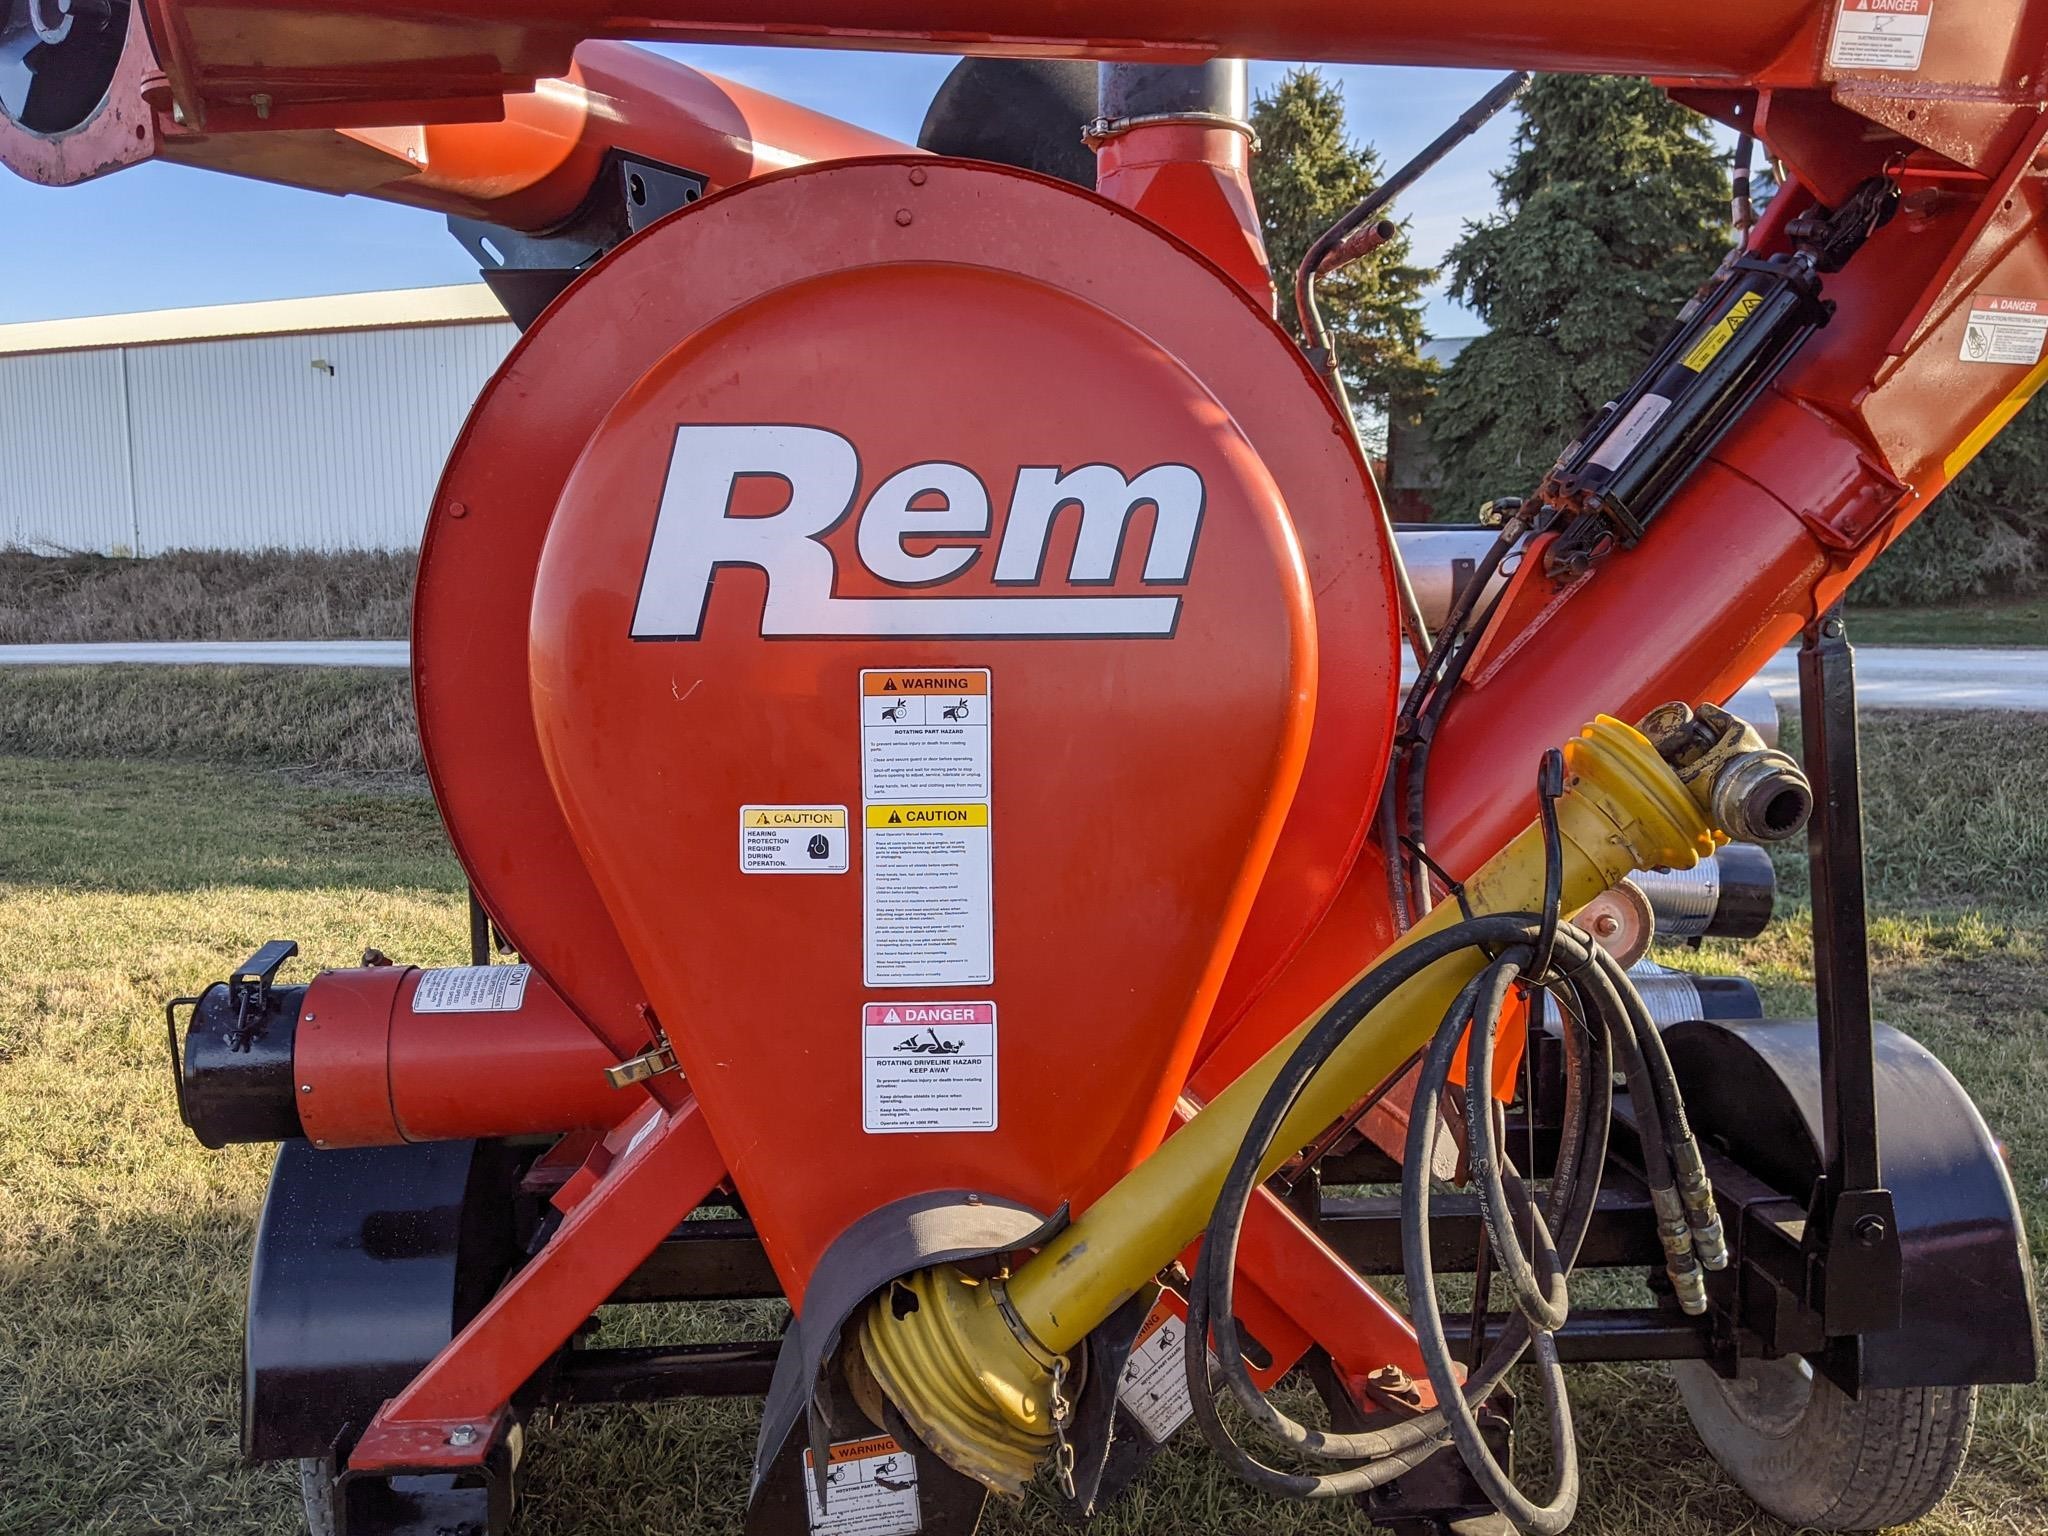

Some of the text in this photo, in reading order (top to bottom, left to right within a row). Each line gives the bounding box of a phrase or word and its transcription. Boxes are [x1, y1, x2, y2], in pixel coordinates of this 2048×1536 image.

[1872, 0, 1918, 11] DANGER
[2001, 300, 2037, 311] DANGER
[628, 422, 1207, 642] Rem
[902, 679, 968, 689] WARNING
[774, 814, 832, 823] CAUTION
[906, 811, 967, 822] CAUTION
[905, 1009, 974, 1021] DANGER
[1157, 1359, 1168, 1370] PART
[839, 1441, 894, 1457] WARNING
